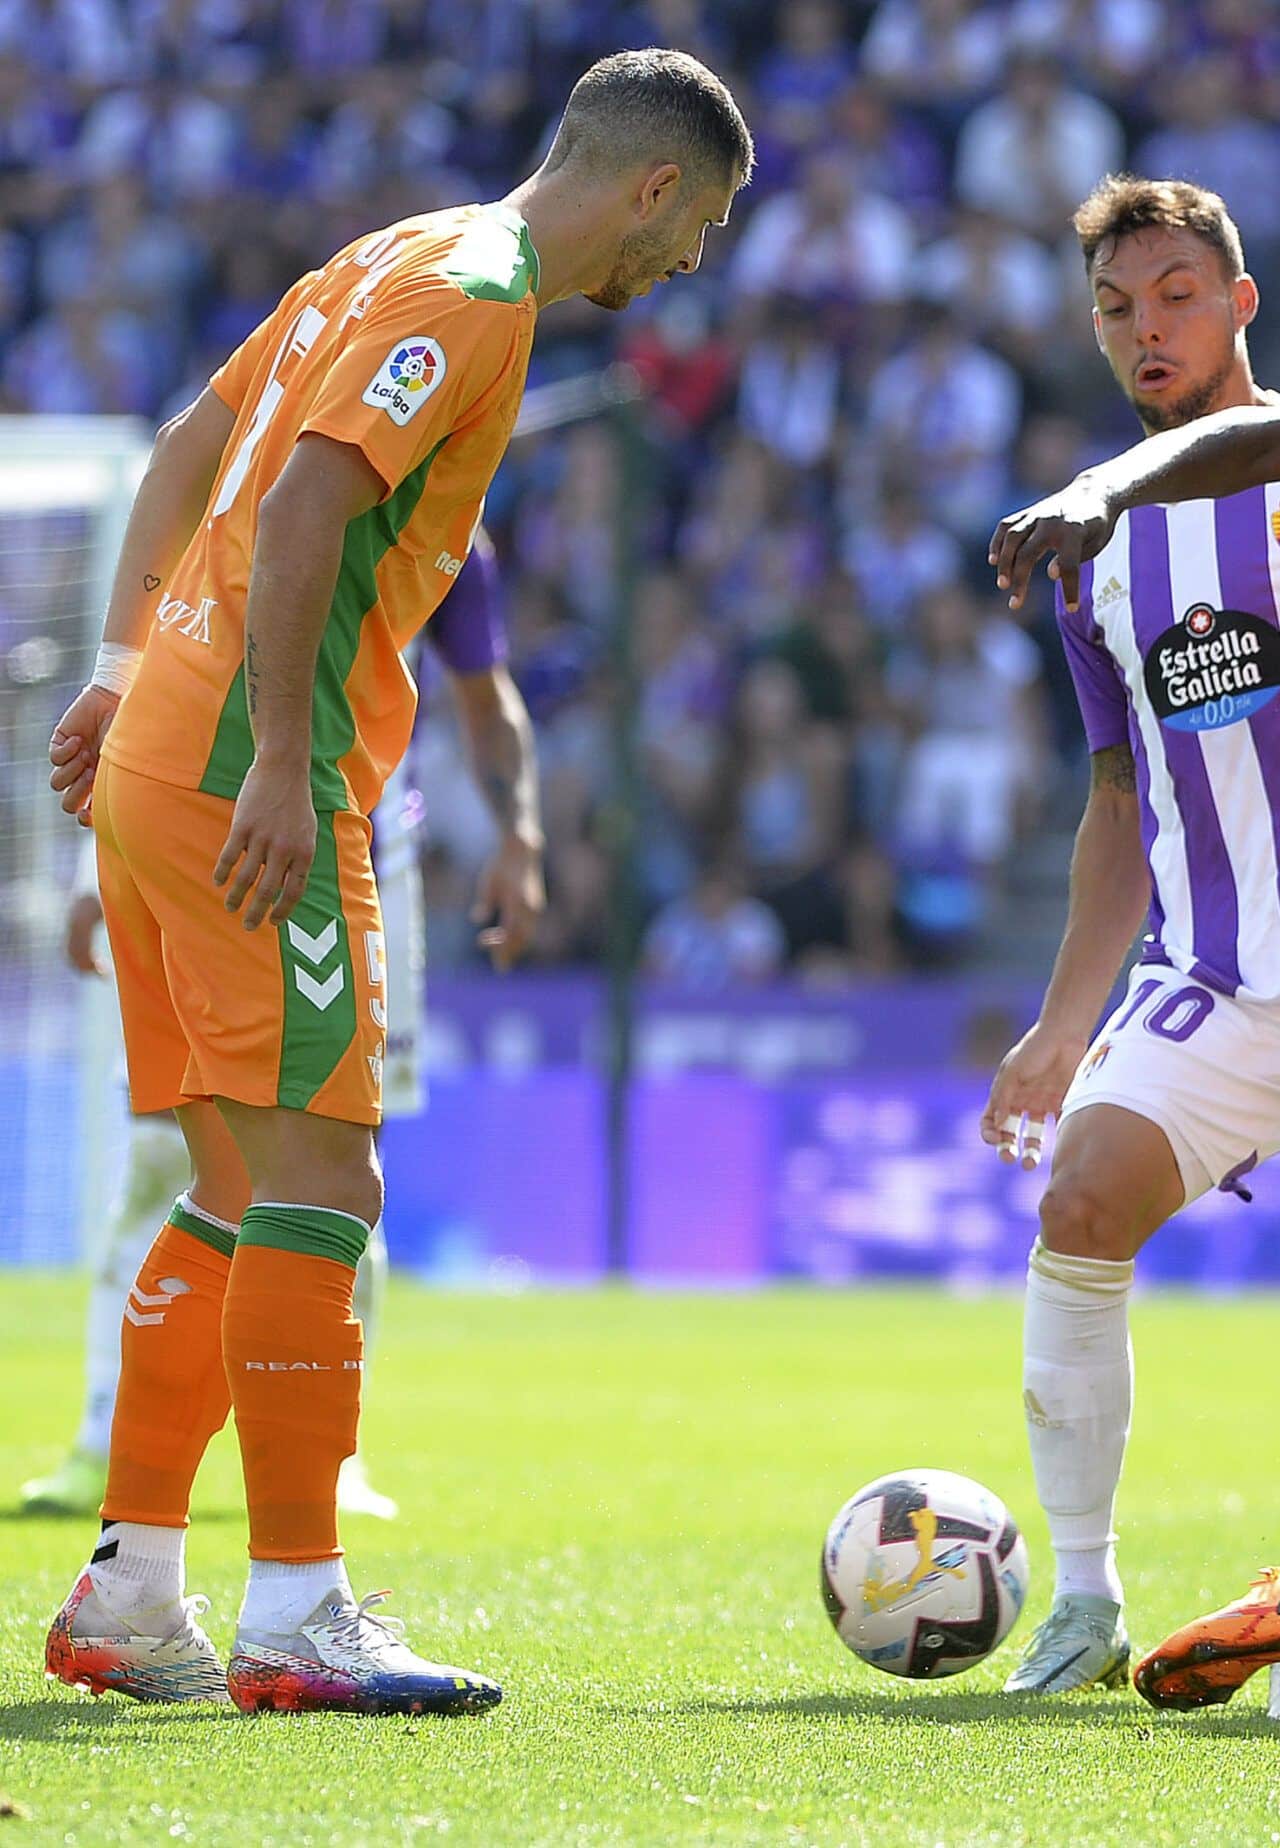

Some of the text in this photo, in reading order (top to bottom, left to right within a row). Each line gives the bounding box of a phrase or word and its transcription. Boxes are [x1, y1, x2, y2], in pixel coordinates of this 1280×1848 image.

[1159, 629, 1261, 680] Estrella
[1167, 660, 1263, 707] Galicia
[1112, 979, 1215, 1042] 10
[246, 1361, 332, 1371] REAL
